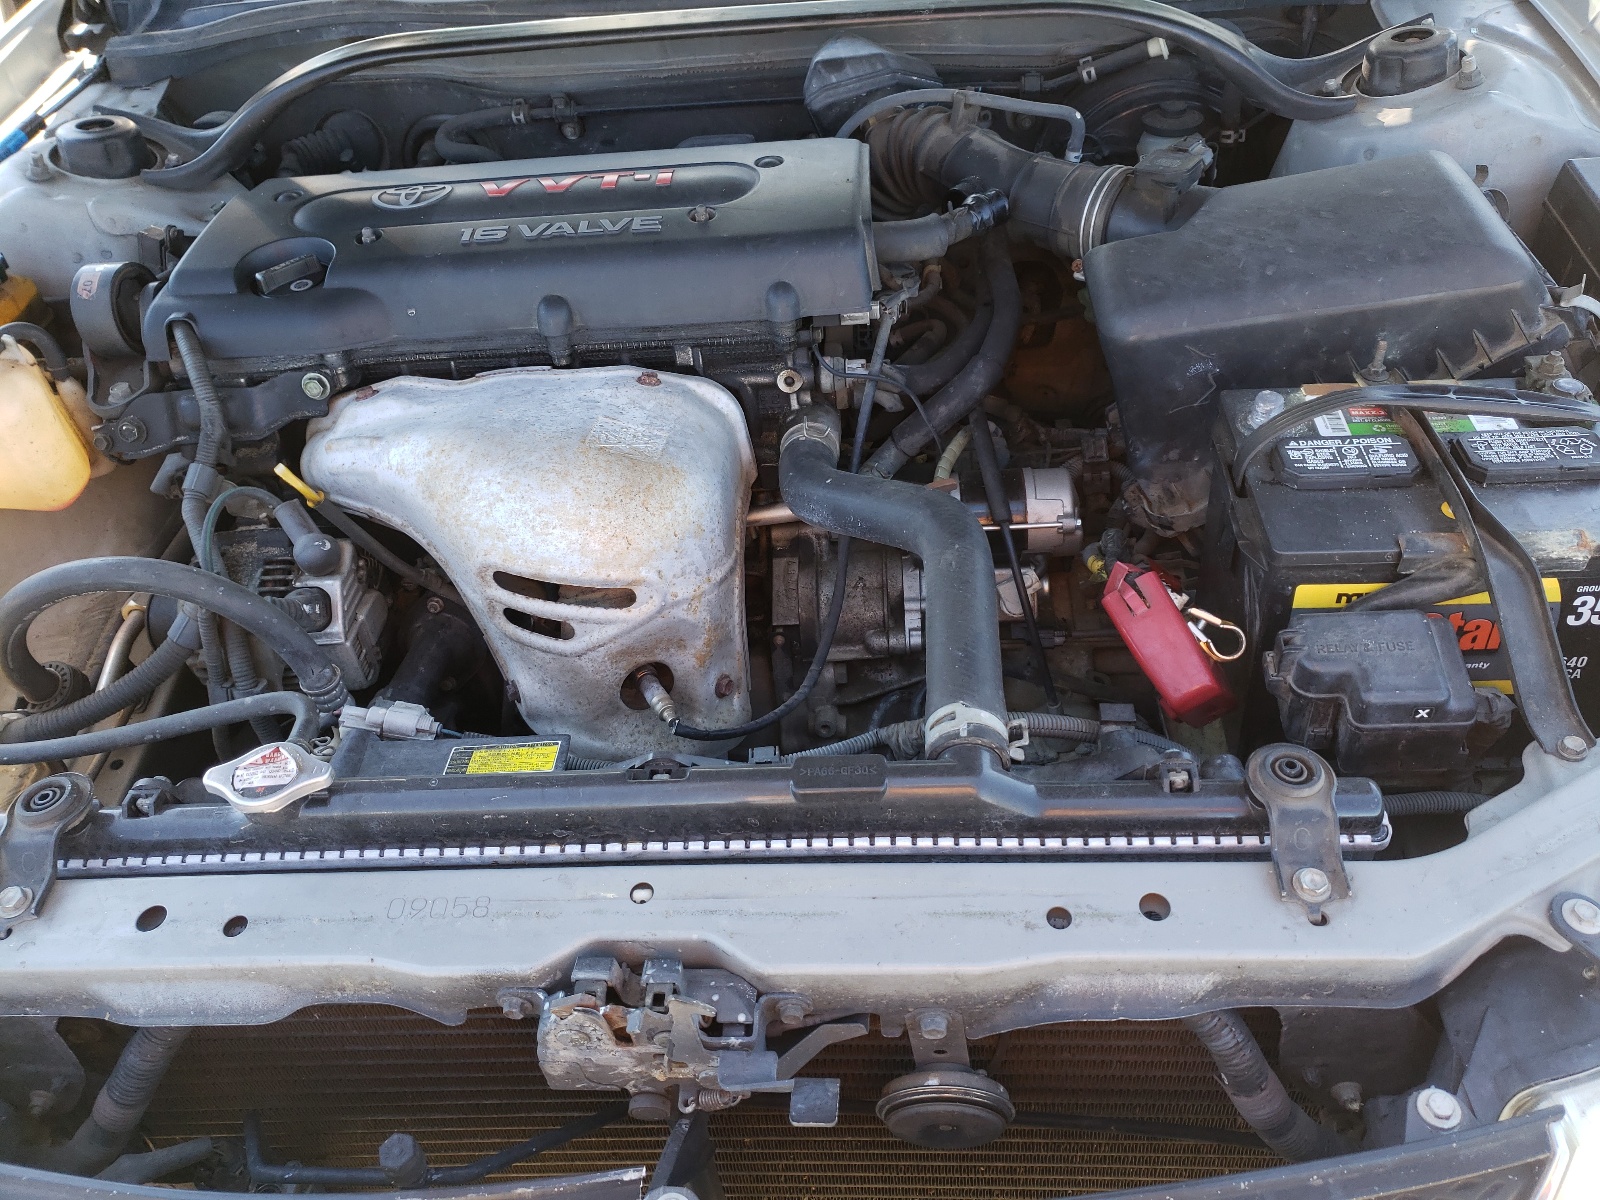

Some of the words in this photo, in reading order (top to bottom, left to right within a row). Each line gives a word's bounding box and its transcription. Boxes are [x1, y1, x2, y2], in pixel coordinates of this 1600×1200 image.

[460, 225, 510, 245] 16
[516, 215, 663, 240] VALVE
[1298, 438, 1342, 447] DANGER
[1352, 437, 1393, 445] POISON
[1577, 585, 1600, 593] GROU
[1317, 642, 1359, 654] RELAY
[1363, 643, 1373, 653] &
[1378, 640, 1415, 652] FUSE
[387, 896, 491, 919] 09058
